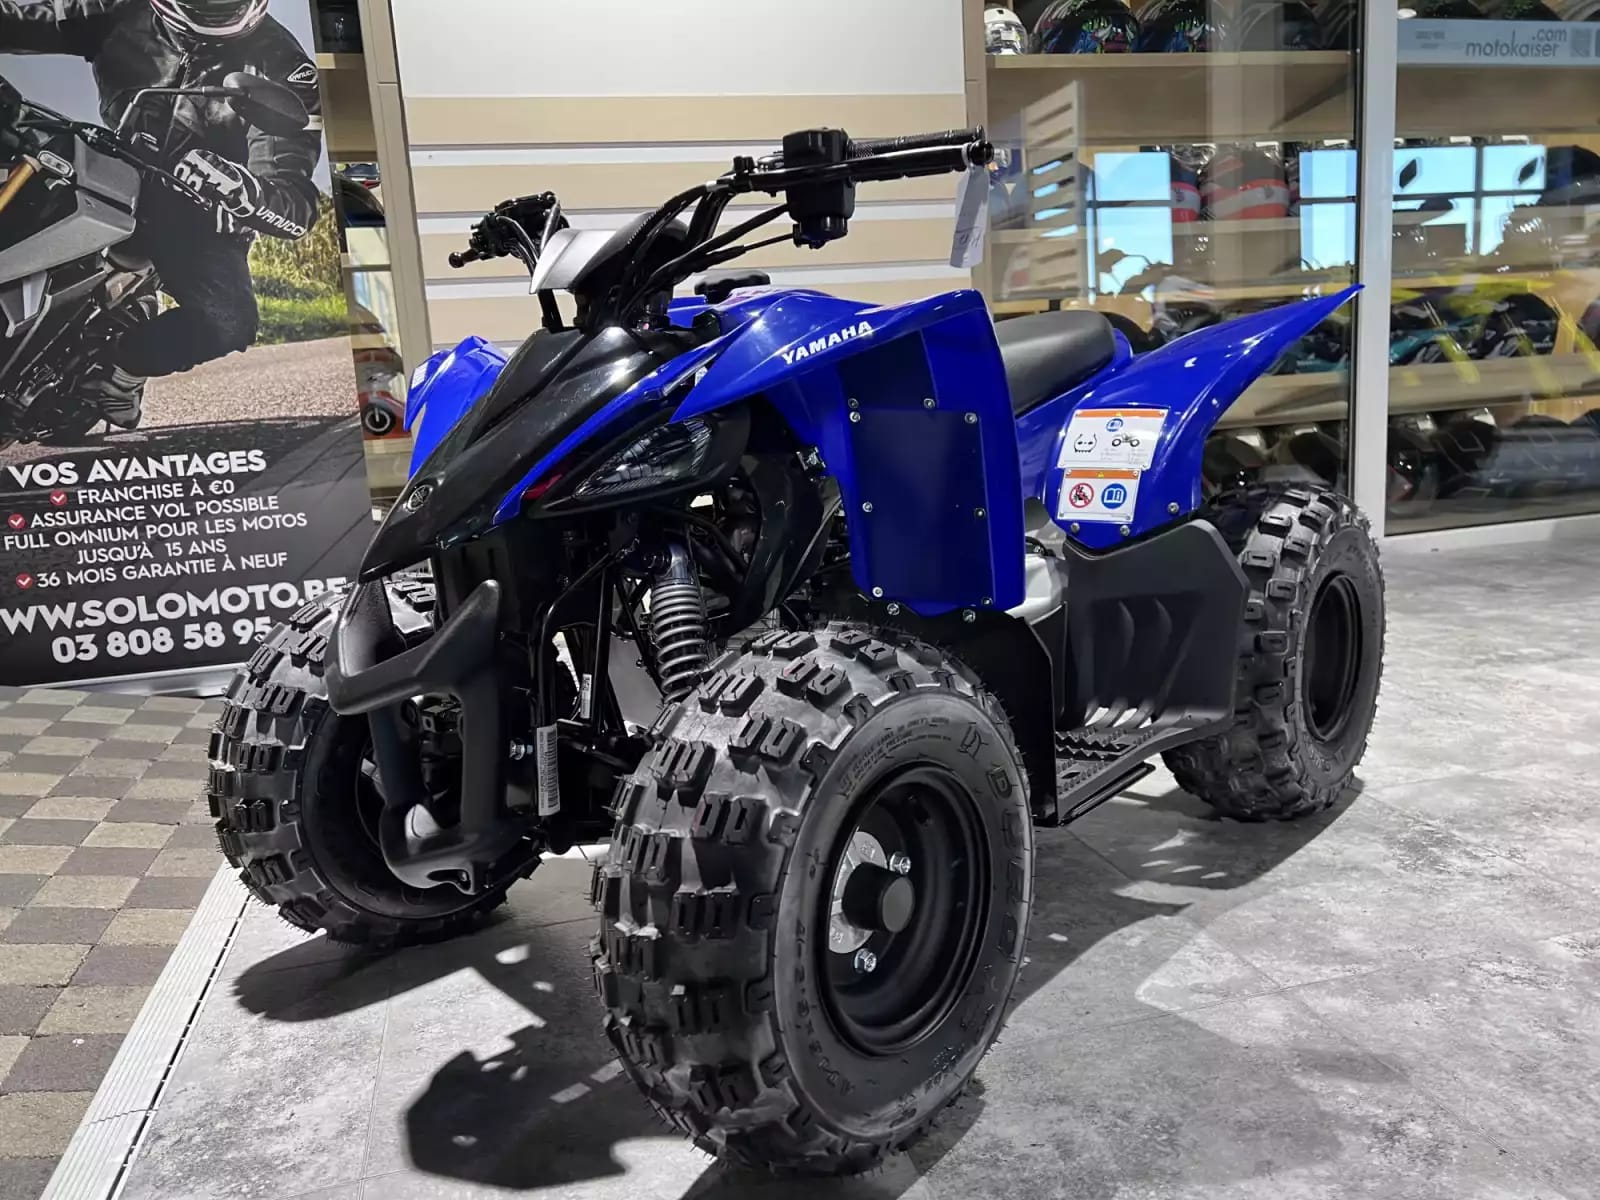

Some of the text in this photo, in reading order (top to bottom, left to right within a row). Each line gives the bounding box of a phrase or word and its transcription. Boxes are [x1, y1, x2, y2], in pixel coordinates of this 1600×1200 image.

[1465, 29, 1560, 57] motokaiser
[1532, 29, 1568, 43] .com
[781, 320, 872, 365] YAMAHA
[8, 449, 267, 489] VOS AVANTAGES
[77, 478, 235, 505] FRANCHISE À €0
[30, 495, 279, 529] ASSURANCE VOL POSSIBLE
[4, 512, 308, 551] FULL OMNIUM POUR LES MOTOS
[77, 538, 227, 565] JUSQU'À 15 ANS
[37, 552, 287, 587] 36 MOIS GARANTIE À NEUF
[51, 616, 273, 663] 03 808 58 95
